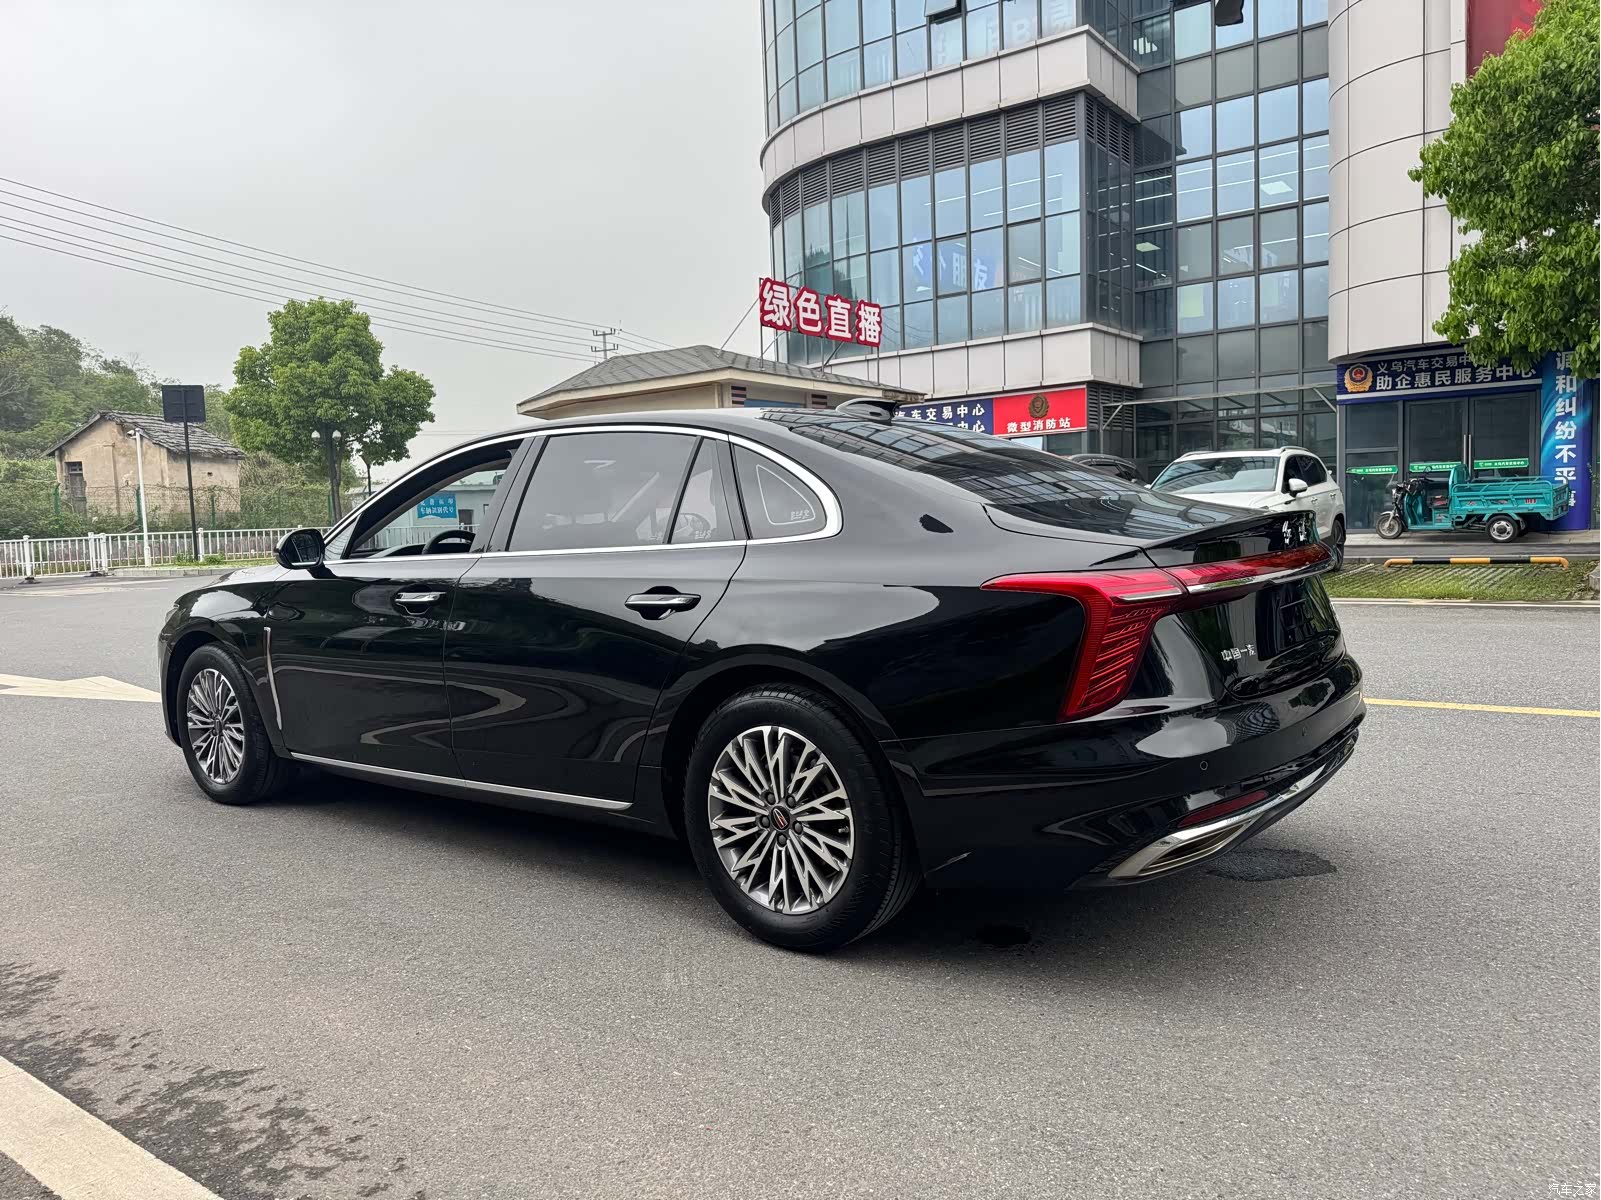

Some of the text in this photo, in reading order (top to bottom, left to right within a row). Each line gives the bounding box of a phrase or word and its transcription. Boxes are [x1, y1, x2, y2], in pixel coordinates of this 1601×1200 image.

[762, 281, 880, 343] 绿色直播
[1376, 365, 1536, 390] 助企惠民服务中心
[1007, 417, 1071, 433] 微型消防站
[1555, 351, 1577, 507] 调和纠纷不平
